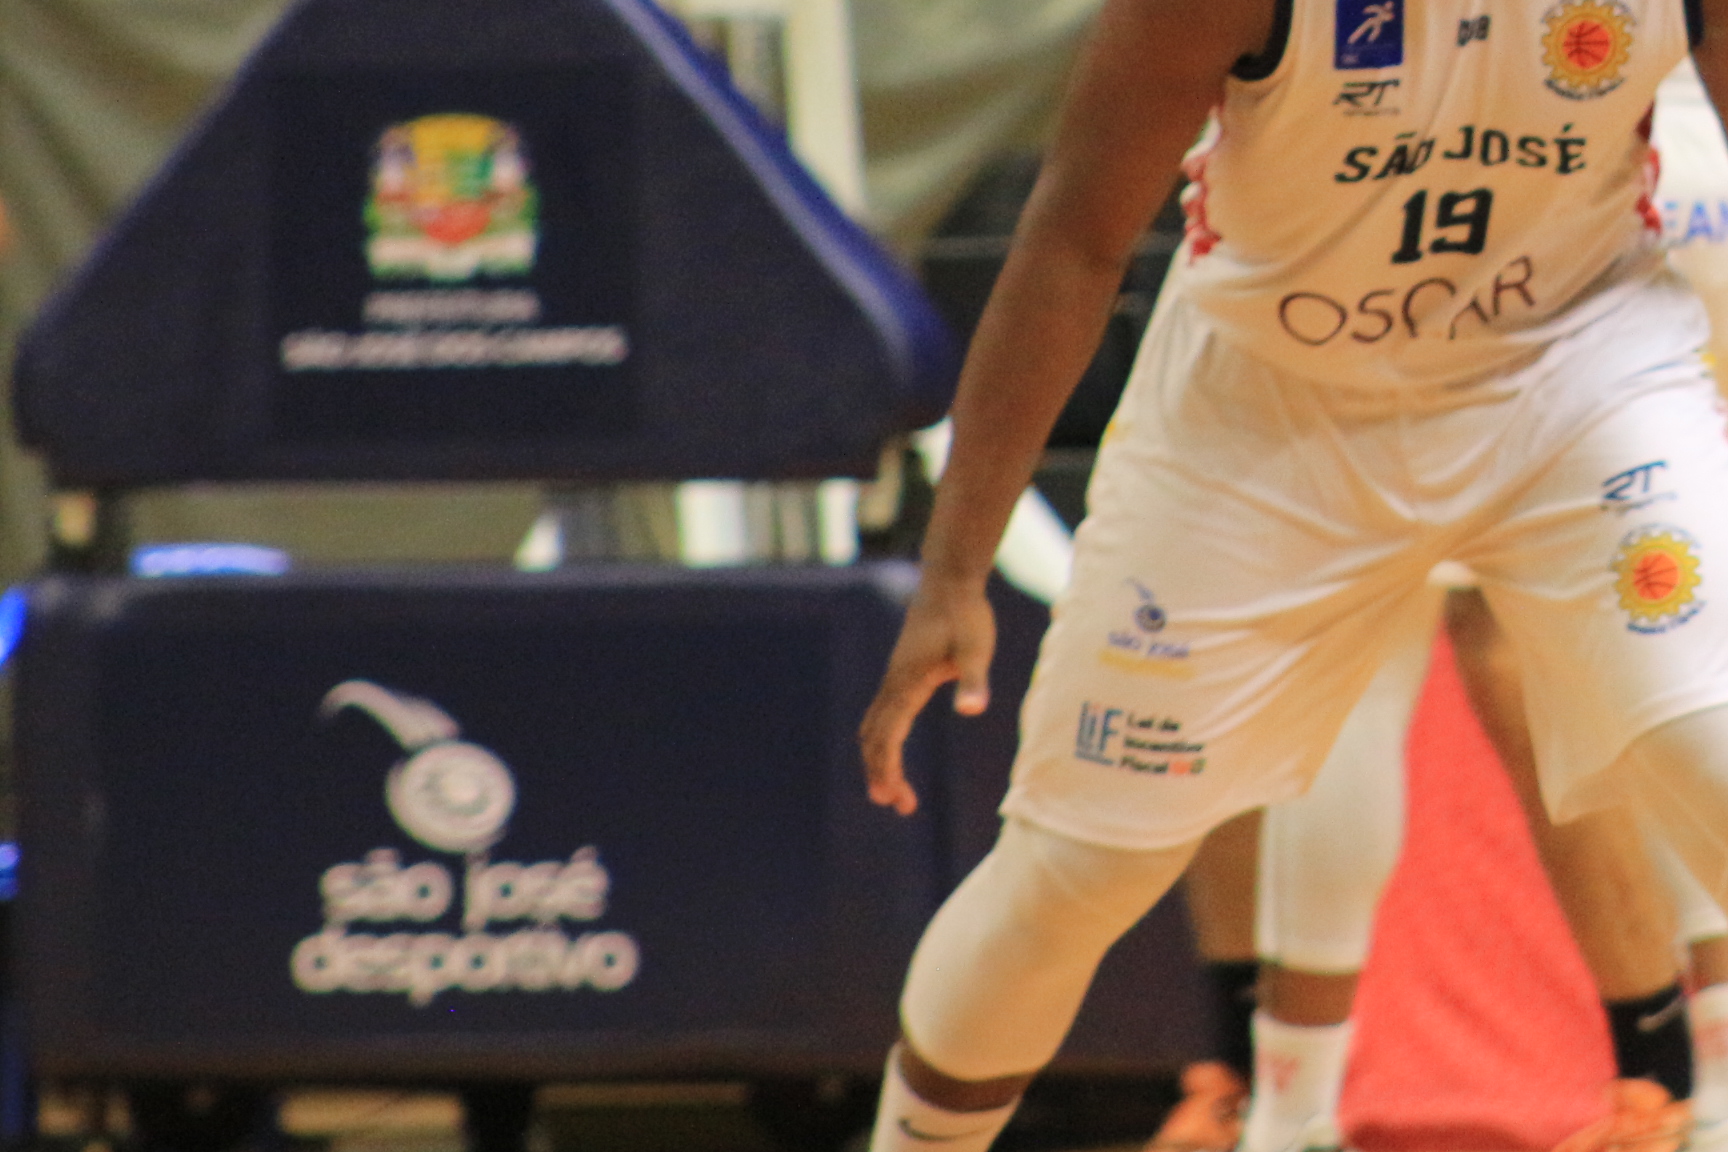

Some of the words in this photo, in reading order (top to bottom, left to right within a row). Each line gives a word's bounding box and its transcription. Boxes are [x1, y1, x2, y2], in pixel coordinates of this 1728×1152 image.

[1334, 131, 1437, 184] SÃO
[1442, 122, 1588, 176] JOSÉ
[1390, 187, 1495, 264] 19
[319, 846, 453, 926] são
[461, 844, 609, 934] josé
[289, 924, 639, 1008] desportivo
